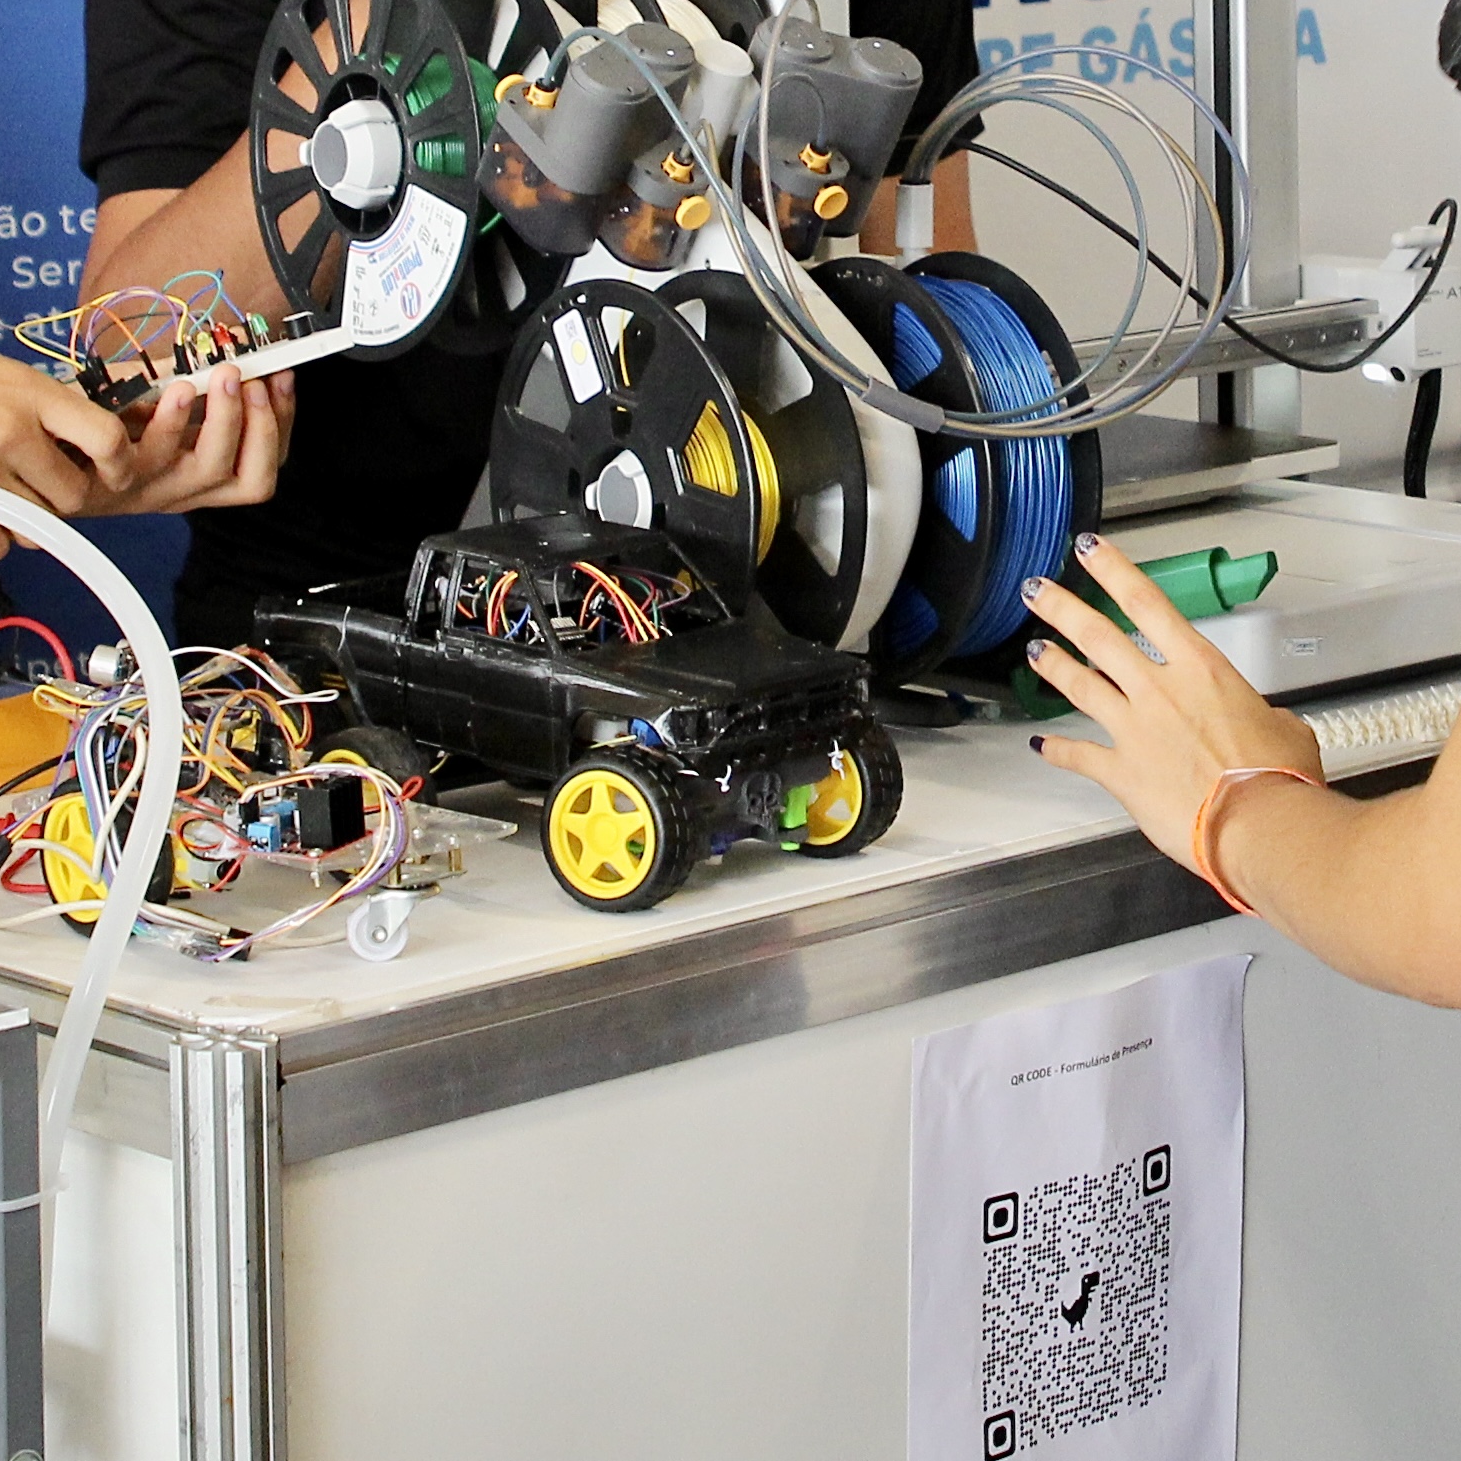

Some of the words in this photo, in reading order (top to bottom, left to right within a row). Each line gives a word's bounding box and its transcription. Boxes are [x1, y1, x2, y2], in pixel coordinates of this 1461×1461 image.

[1010, 1073, 1024, 1086] QR
[1026, 1066, 1052, 1082] CODE
[1061, 1053, 1111, 1074] Formulário
[1112, 1050, 1121, 1061] de
[1122, 1037, 1153, 1057] Presença
